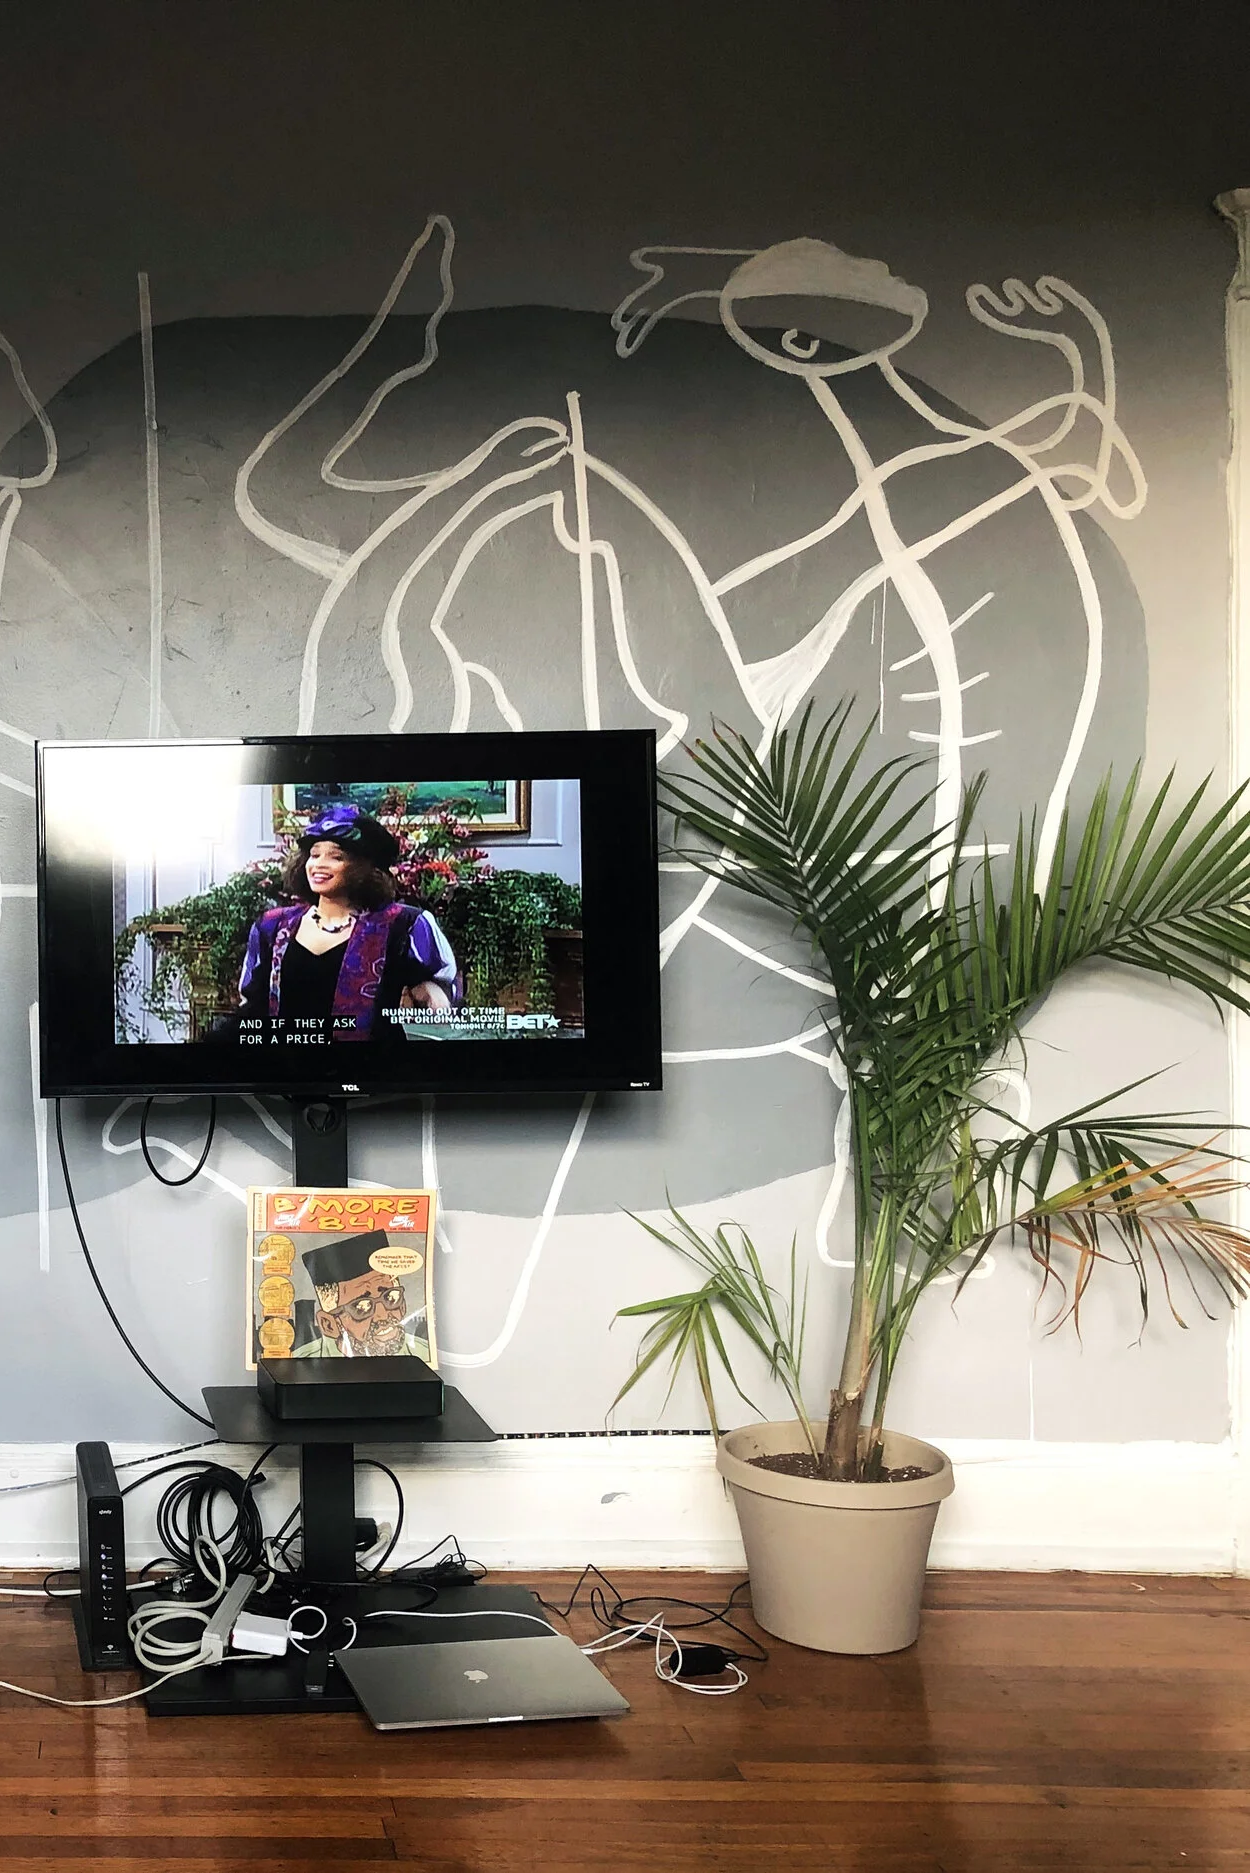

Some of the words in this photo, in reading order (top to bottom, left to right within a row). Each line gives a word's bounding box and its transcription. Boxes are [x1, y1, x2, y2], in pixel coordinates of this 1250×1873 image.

[382, 1008, 433, 1016] RUNNING
[435, 1007, 458, 1016] OUT
[460, 1007, 475, 1016] OF
[478, 1006, 506, 1016] TIME
[239, 1019, 263, 1029] AND
[270, 1018, 286, 1029] IF
[294, 1018, 325, 1028] THEY
[333, 1018, 356, 1028] ASK
[415, 1015, 468, 1024] ORIGINAL
[470, 1014, 506, 1023] MOVIE
[507, 1014, 550, 1030] BET
[239, 1034, 263, 1044] FOR
[270, 1034, 279, 1044] A
[286, 1033, 331, 1045] PRICE,
[273, 1197, 419, 1216] B'MORE
